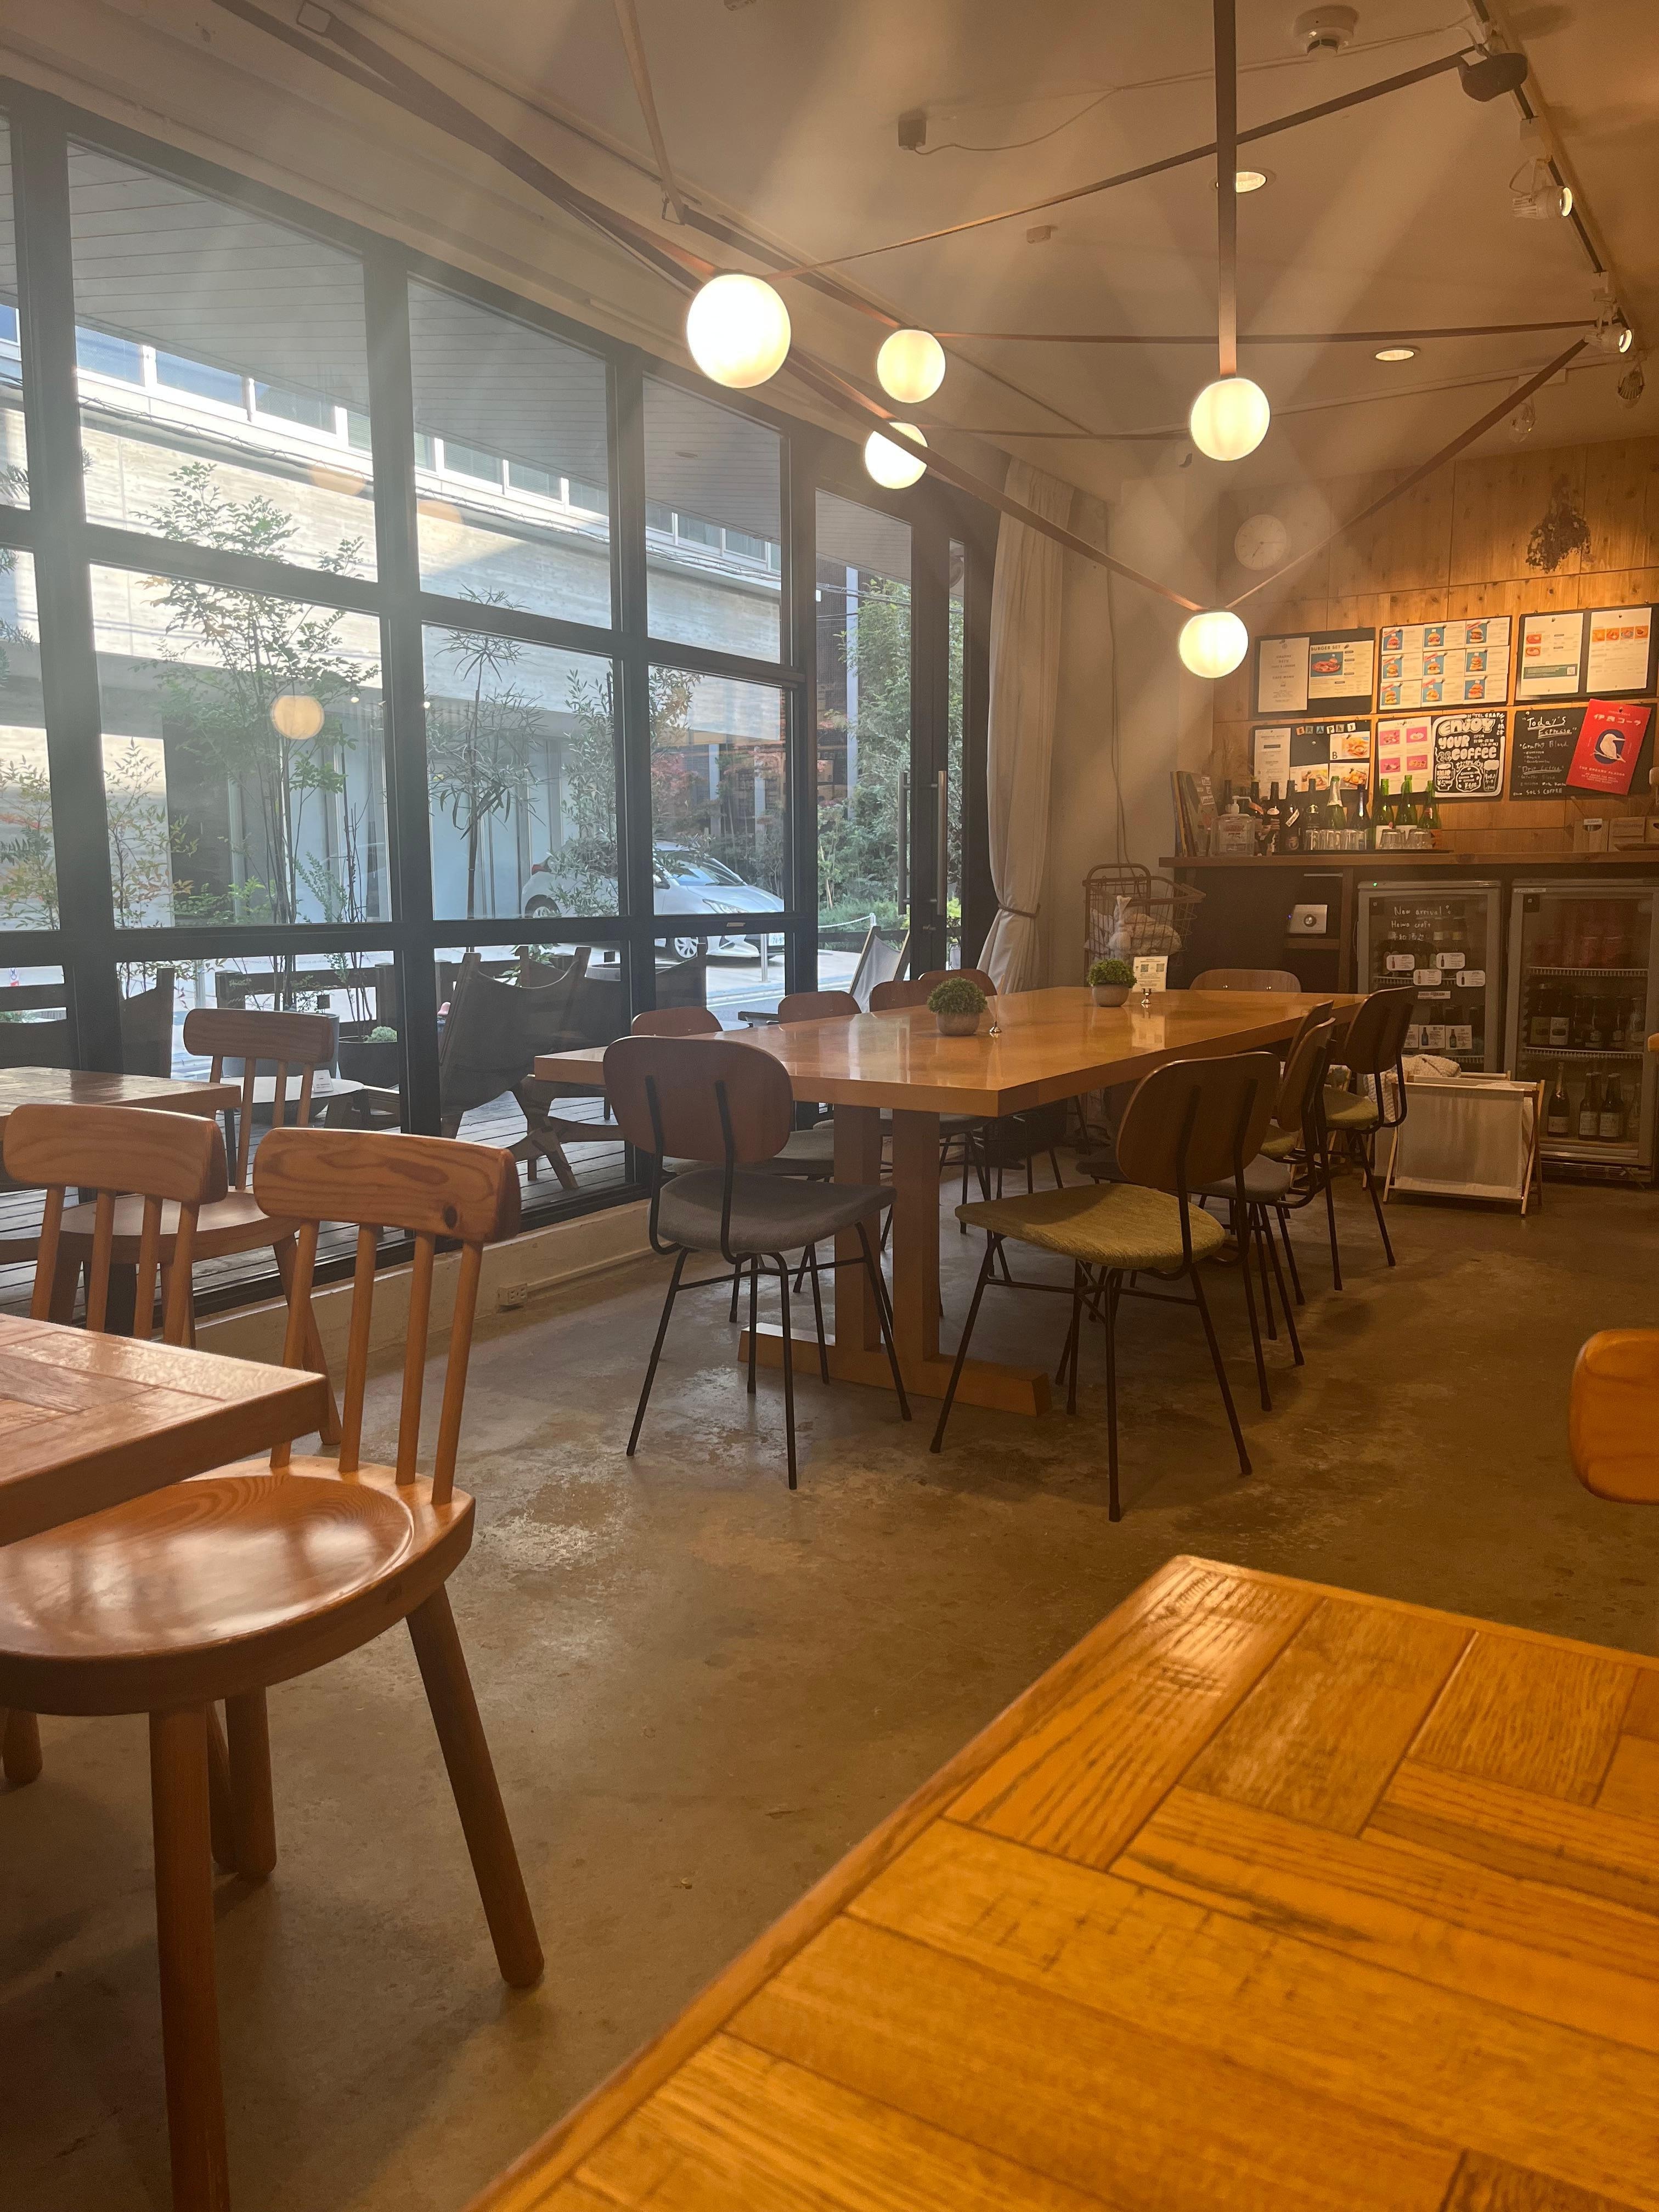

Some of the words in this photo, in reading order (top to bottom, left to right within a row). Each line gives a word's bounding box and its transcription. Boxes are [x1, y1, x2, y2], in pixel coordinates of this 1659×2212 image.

[1394, 906, 1410, 916] New
[1391, 920, 1410, 929] Heiwa
[1414, 920, 1431, 928] craft
